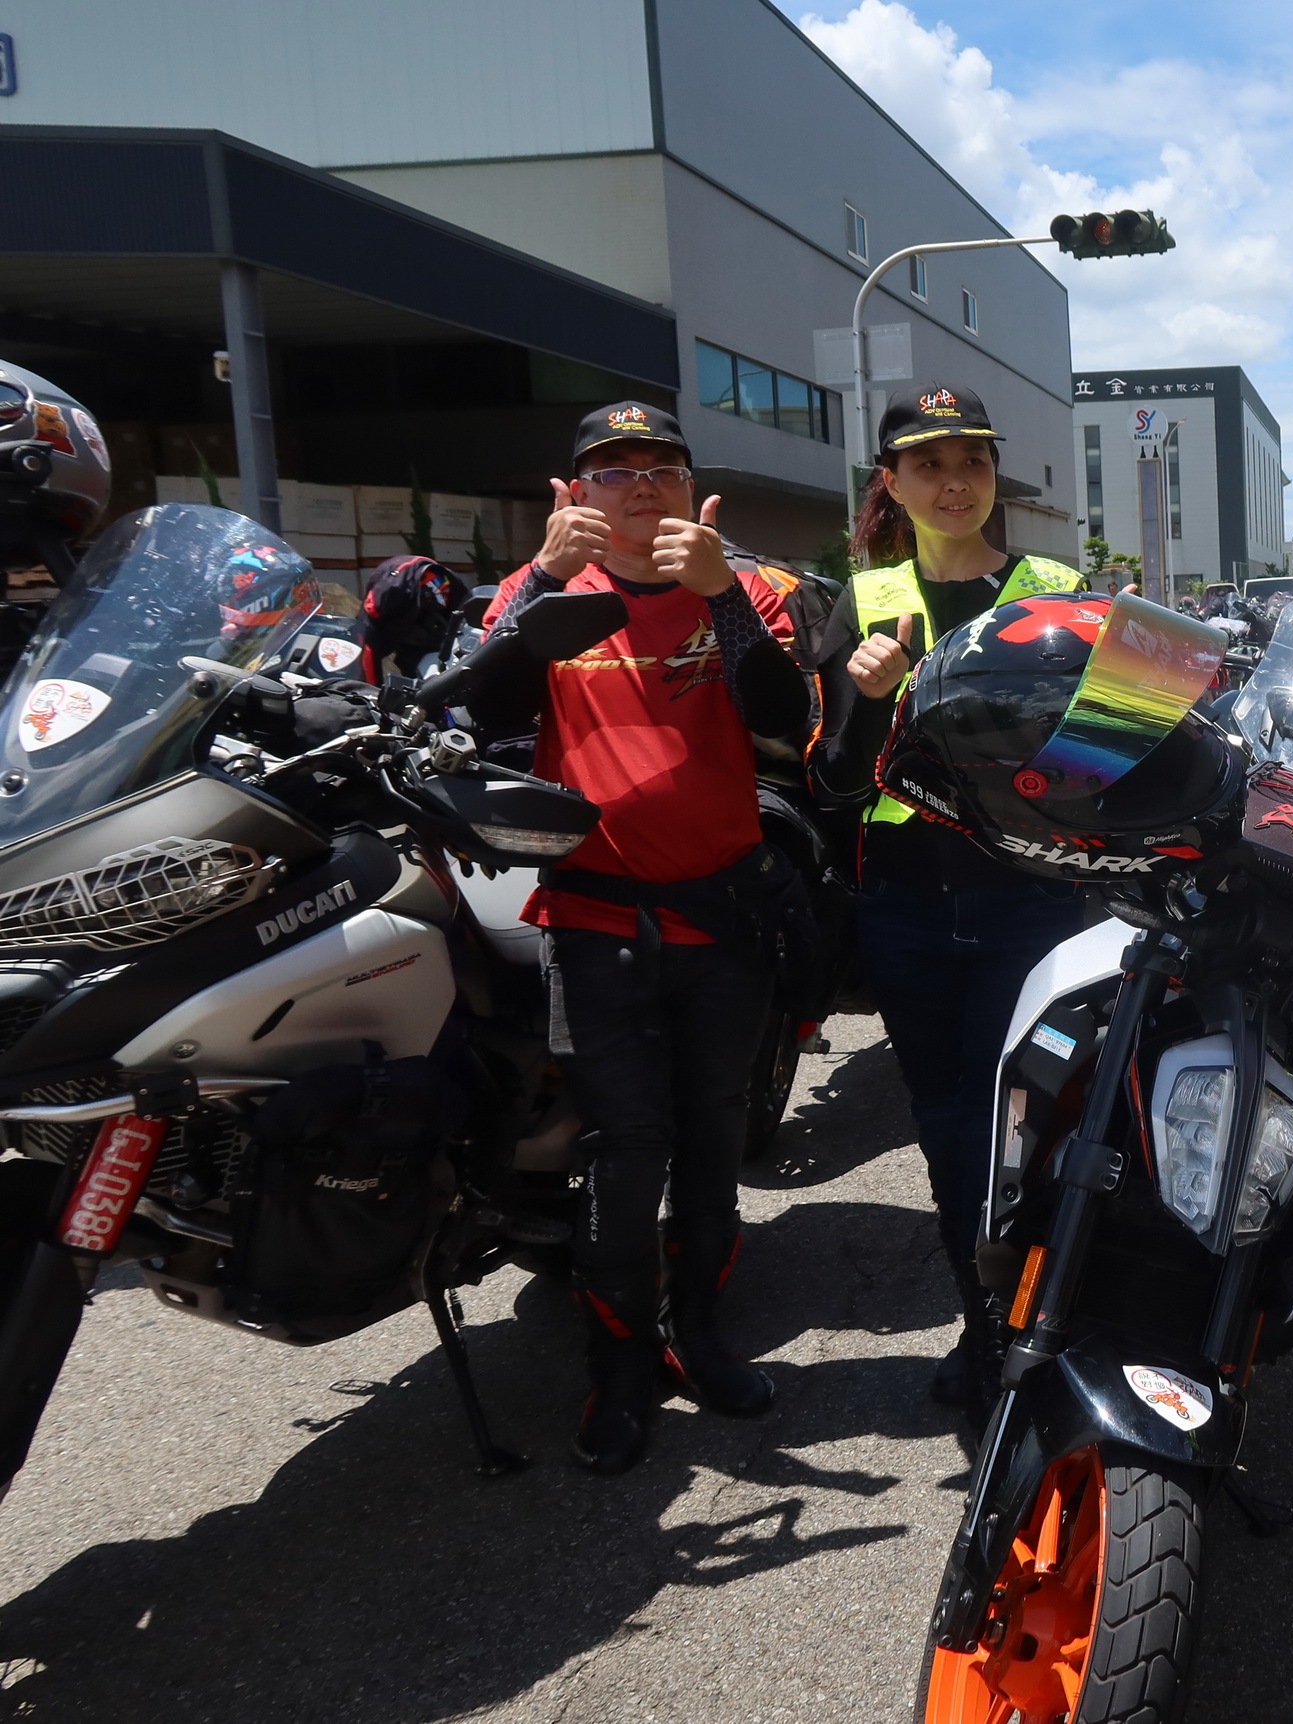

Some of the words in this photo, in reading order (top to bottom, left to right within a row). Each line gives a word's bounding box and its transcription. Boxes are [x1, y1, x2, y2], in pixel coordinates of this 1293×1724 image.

[902, 778, 924, 800] #99
[995, 834, 1168, 873] SHARK
[256, 879, 357, 946] DUCATI
[314, 1173, 380, 1192] Kriega
